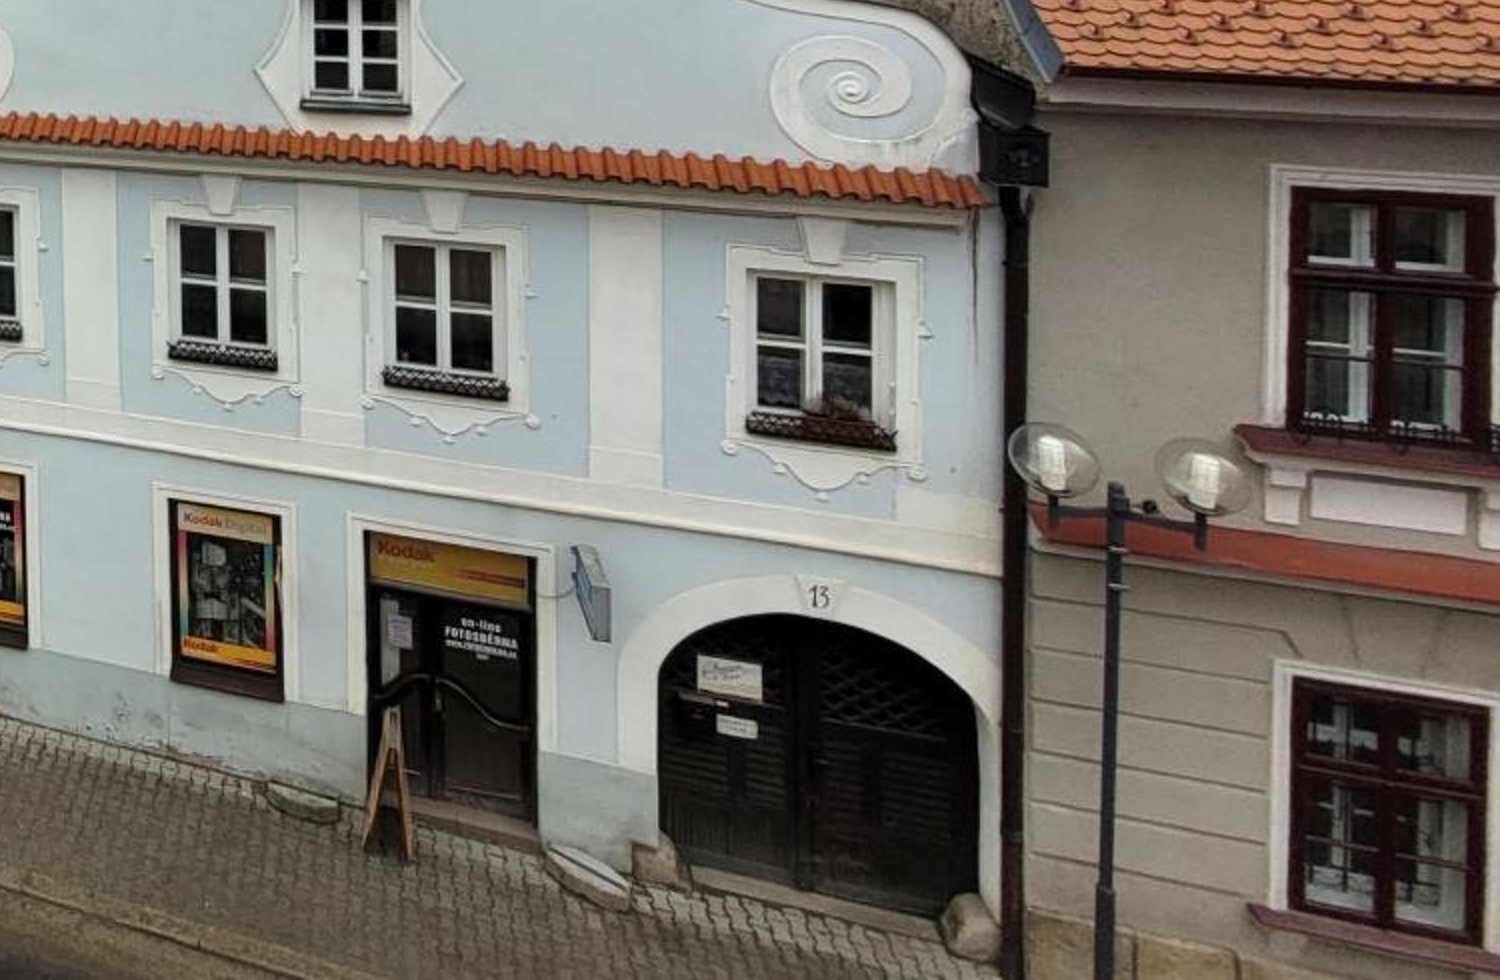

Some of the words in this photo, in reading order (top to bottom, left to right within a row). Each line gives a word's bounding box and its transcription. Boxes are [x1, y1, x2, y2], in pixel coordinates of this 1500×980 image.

[182, 509, 224, 529] Kodak
[378, 538, 436, 563] Kodak
[808, 585, 830, 609] 13
